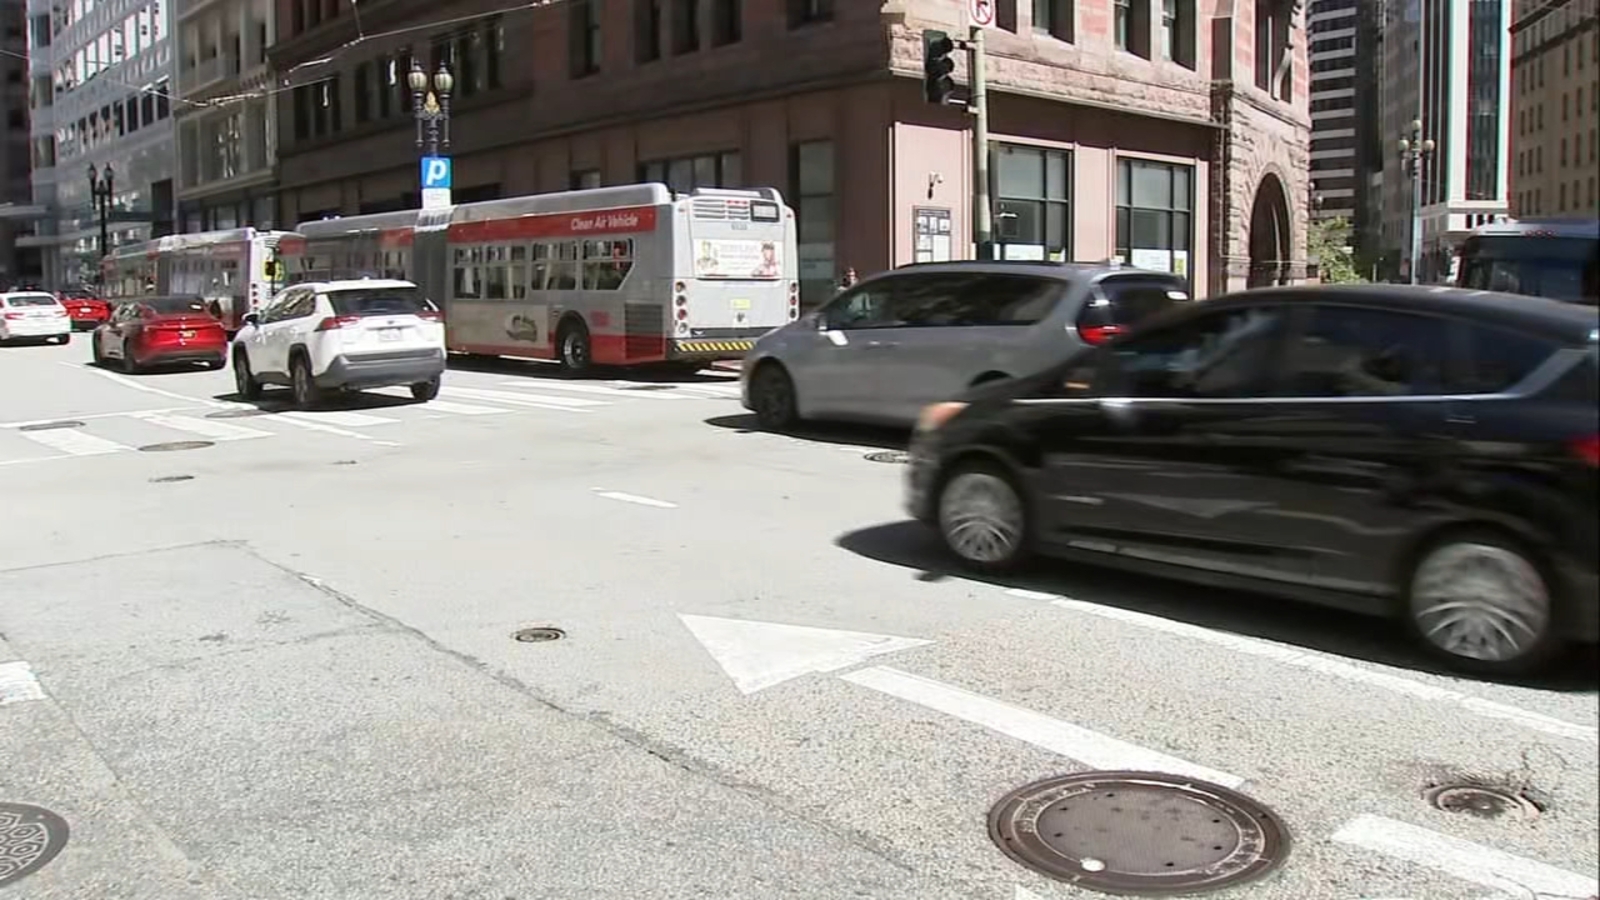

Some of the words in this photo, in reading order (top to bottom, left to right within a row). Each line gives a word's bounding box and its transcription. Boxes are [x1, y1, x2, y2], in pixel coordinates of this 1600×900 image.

[571, 217, 594, 231] Clean
[594, 215, 608, 229] Air
[608, 212, 638, 227] Vehicle
